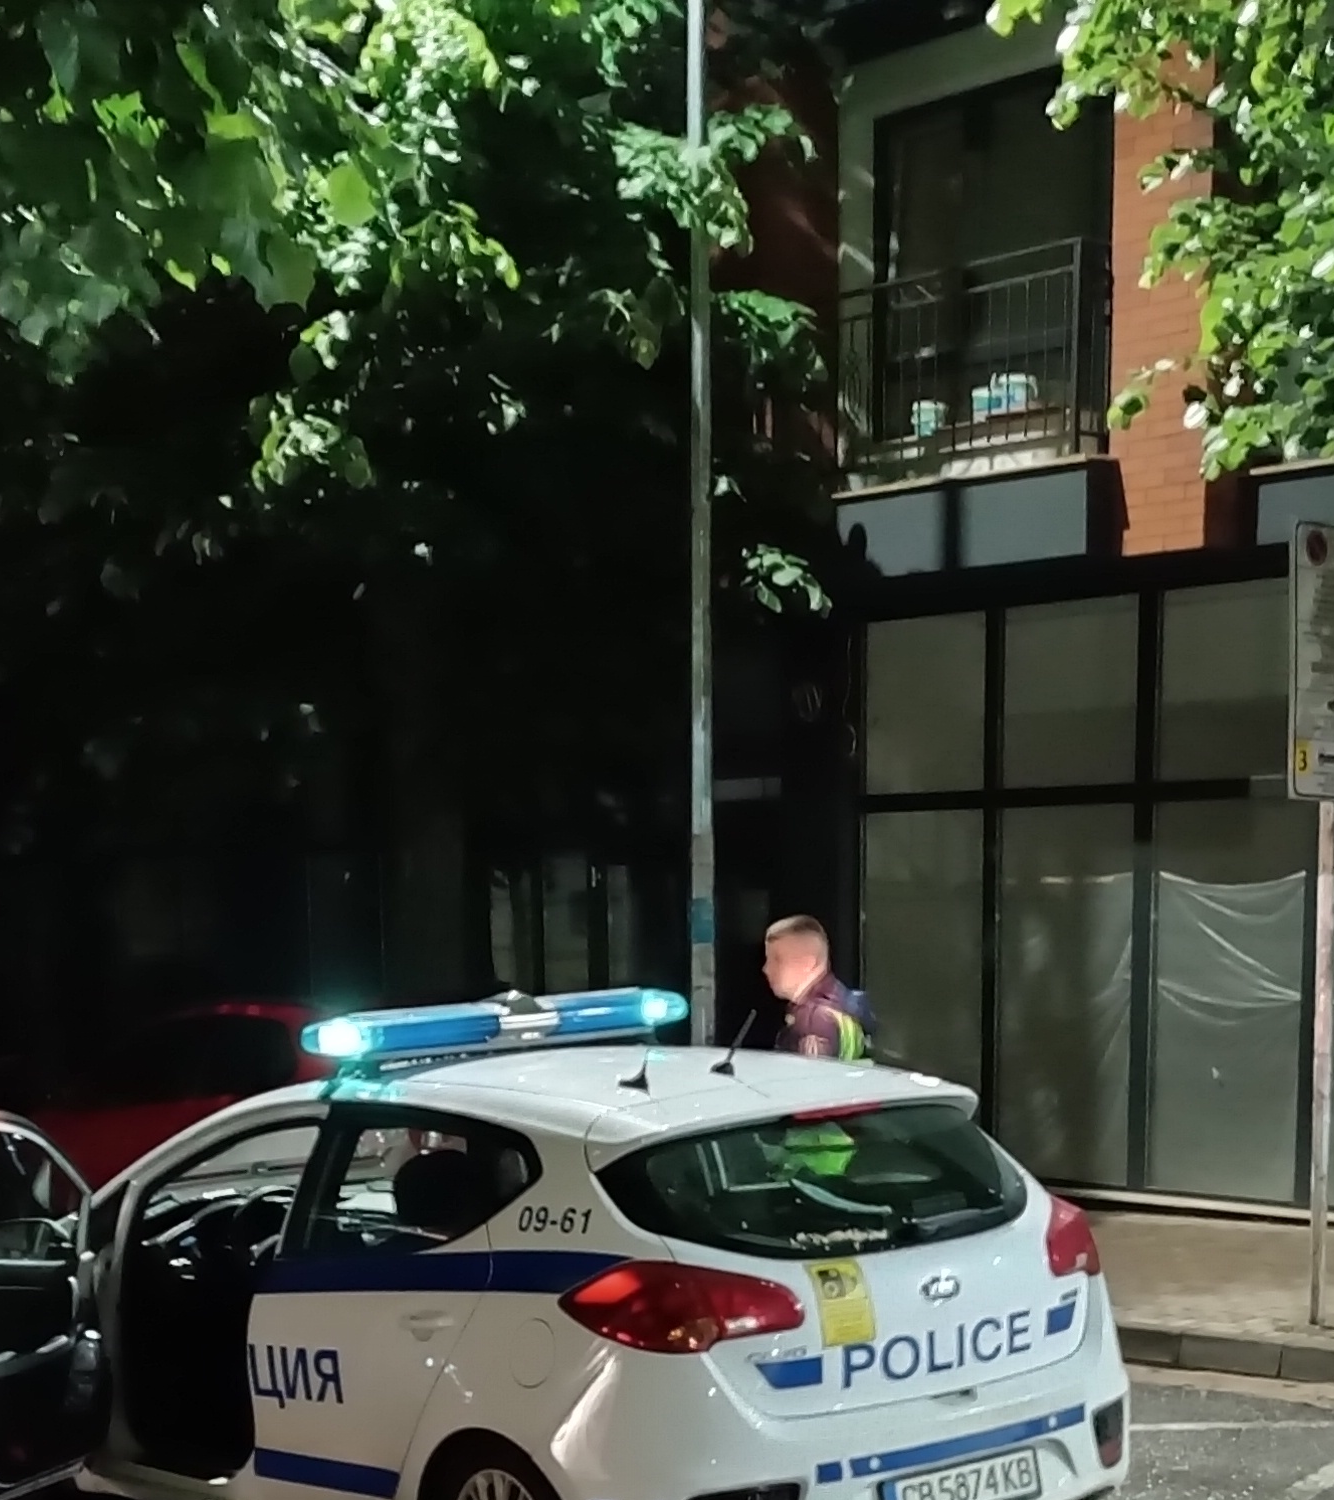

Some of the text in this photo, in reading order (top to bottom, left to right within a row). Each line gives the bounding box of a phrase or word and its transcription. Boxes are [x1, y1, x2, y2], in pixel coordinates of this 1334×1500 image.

[1297, 750, 1308, 772] 3
[518, 1205, 592, 1235] 09-61
[841, 1309, 1032, 1389] POLICE
[248, 1343, 344, 1409] ЦИЯ
